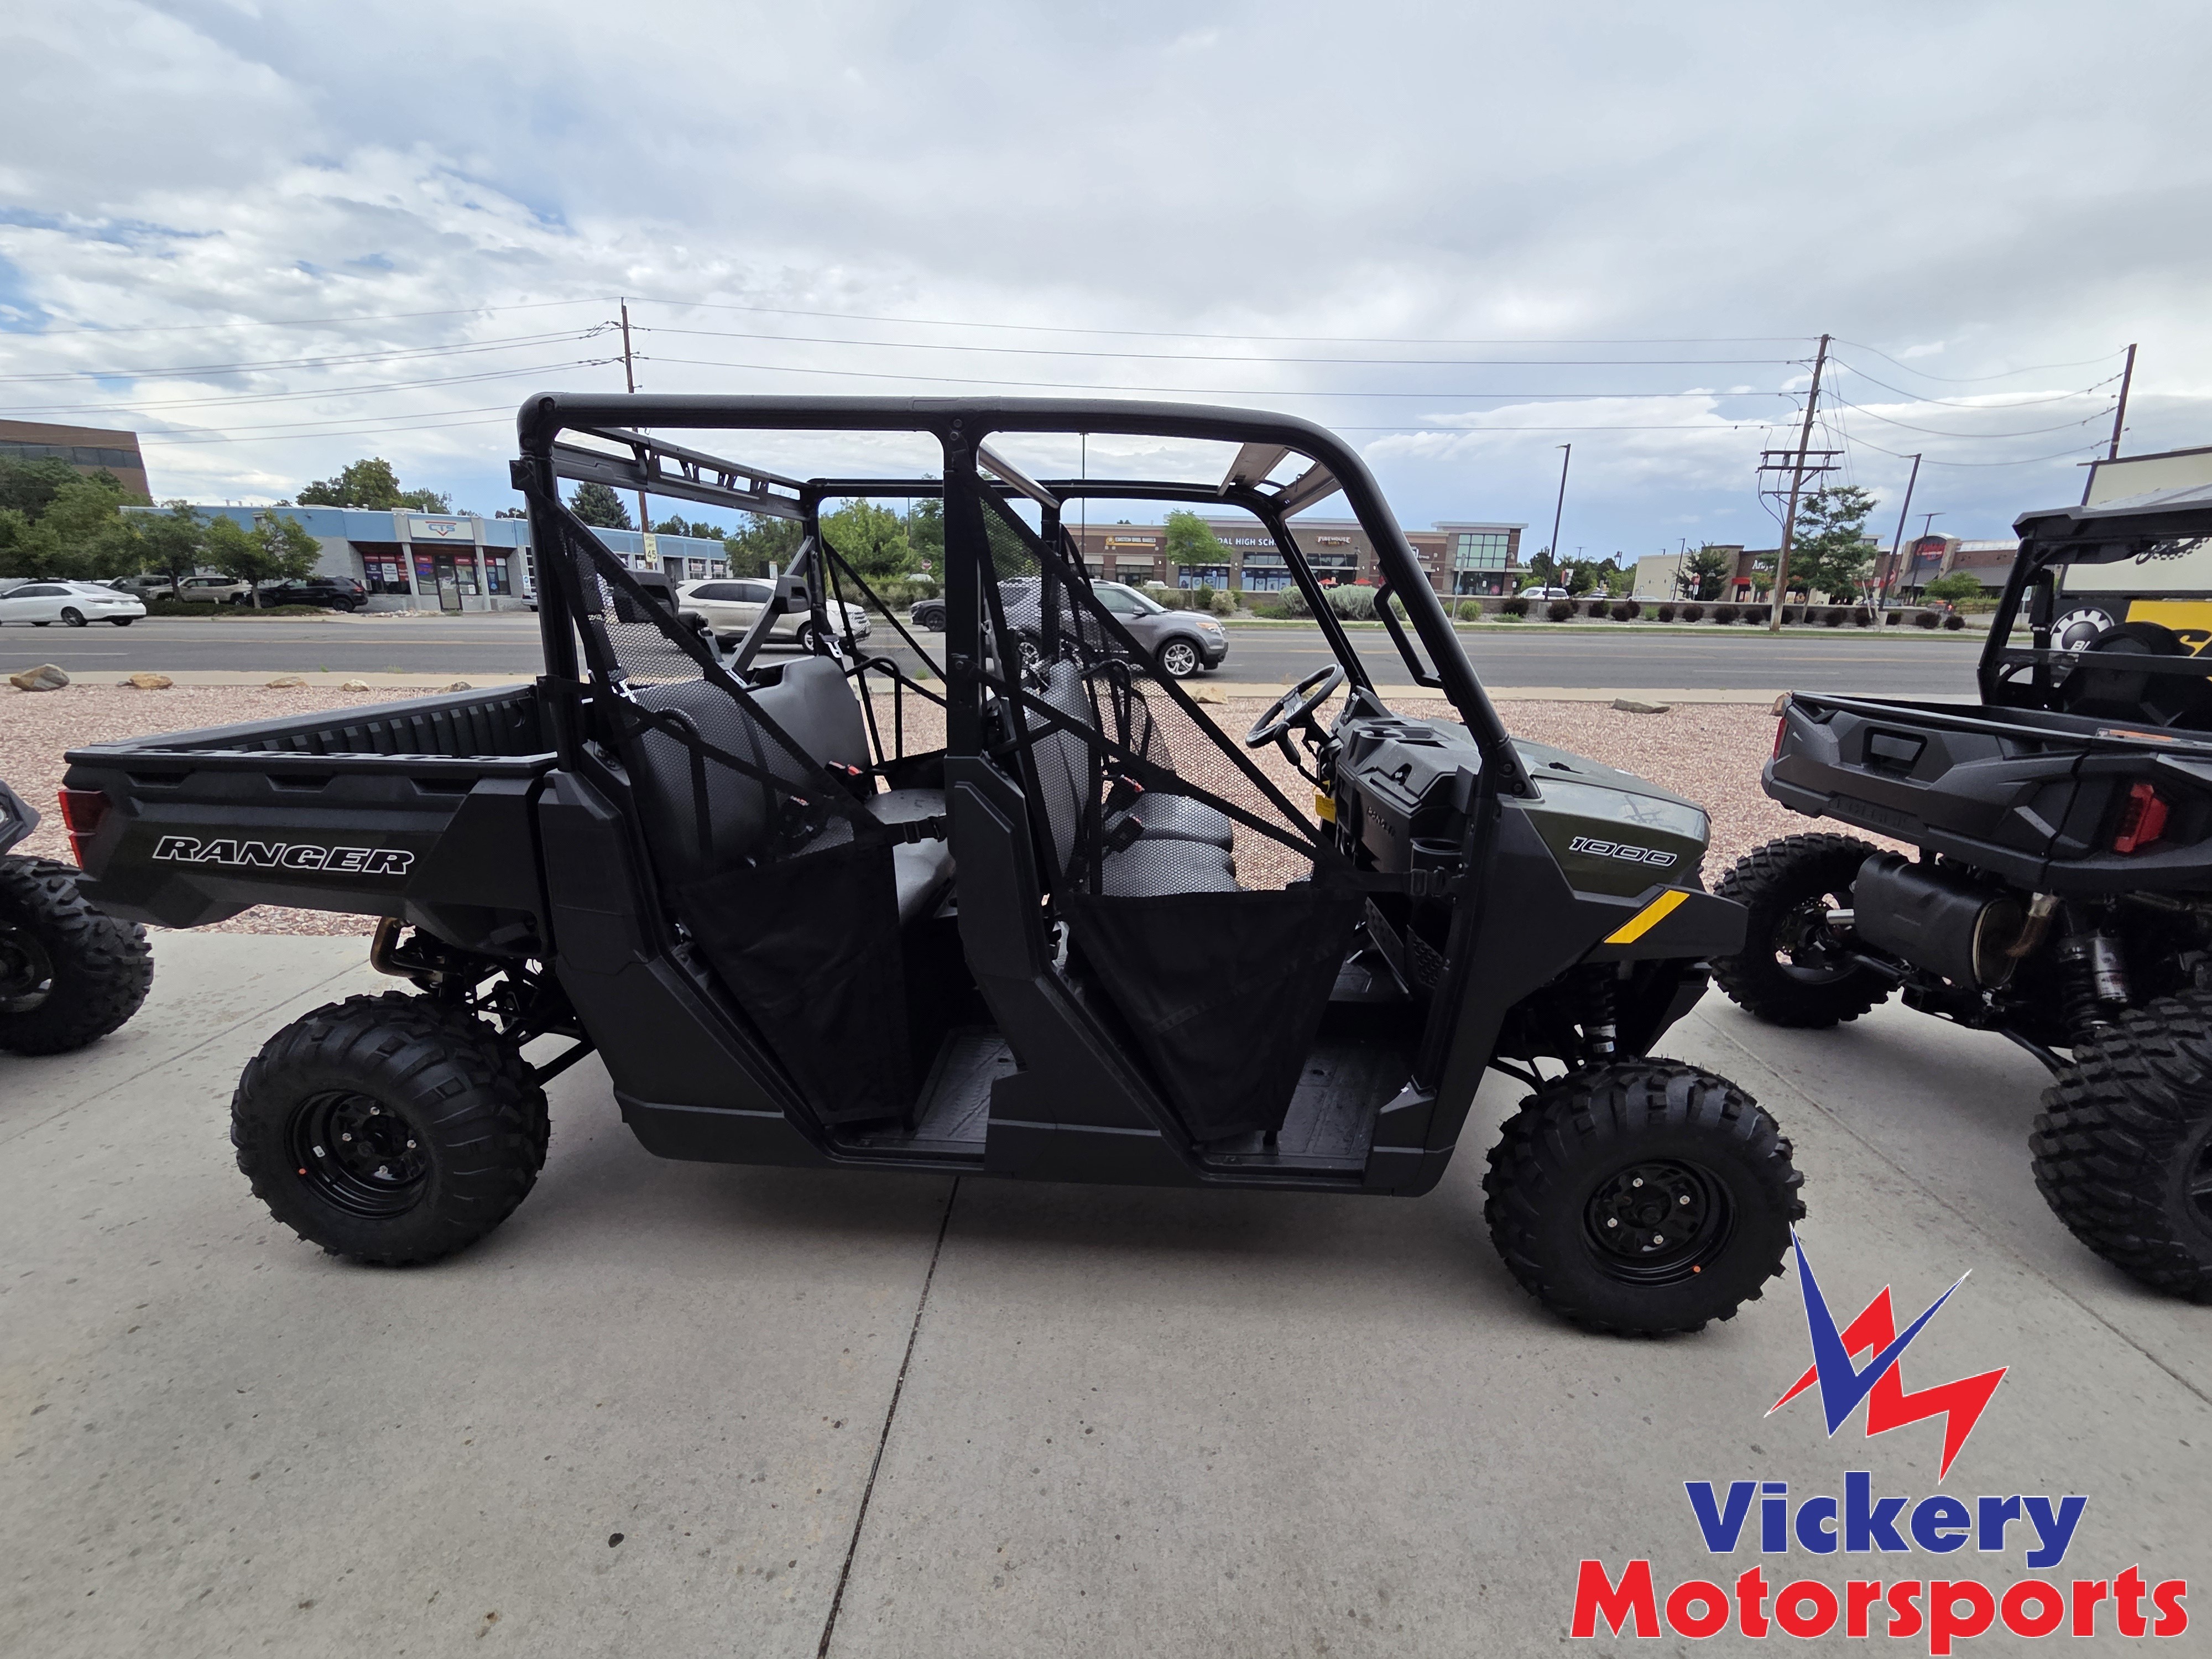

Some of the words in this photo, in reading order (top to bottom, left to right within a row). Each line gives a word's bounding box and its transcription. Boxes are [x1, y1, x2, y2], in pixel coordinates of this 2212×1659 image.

[428, 523, 456, 532] CTS
[1235, 538, 1256, 546] HIGH
[1258, 538, 1277, 546] SCH
[647, 550, 657, 559] 45
[152, 836, 415, 875] RANGER
[1568, 836, 1678, 867] 1000
